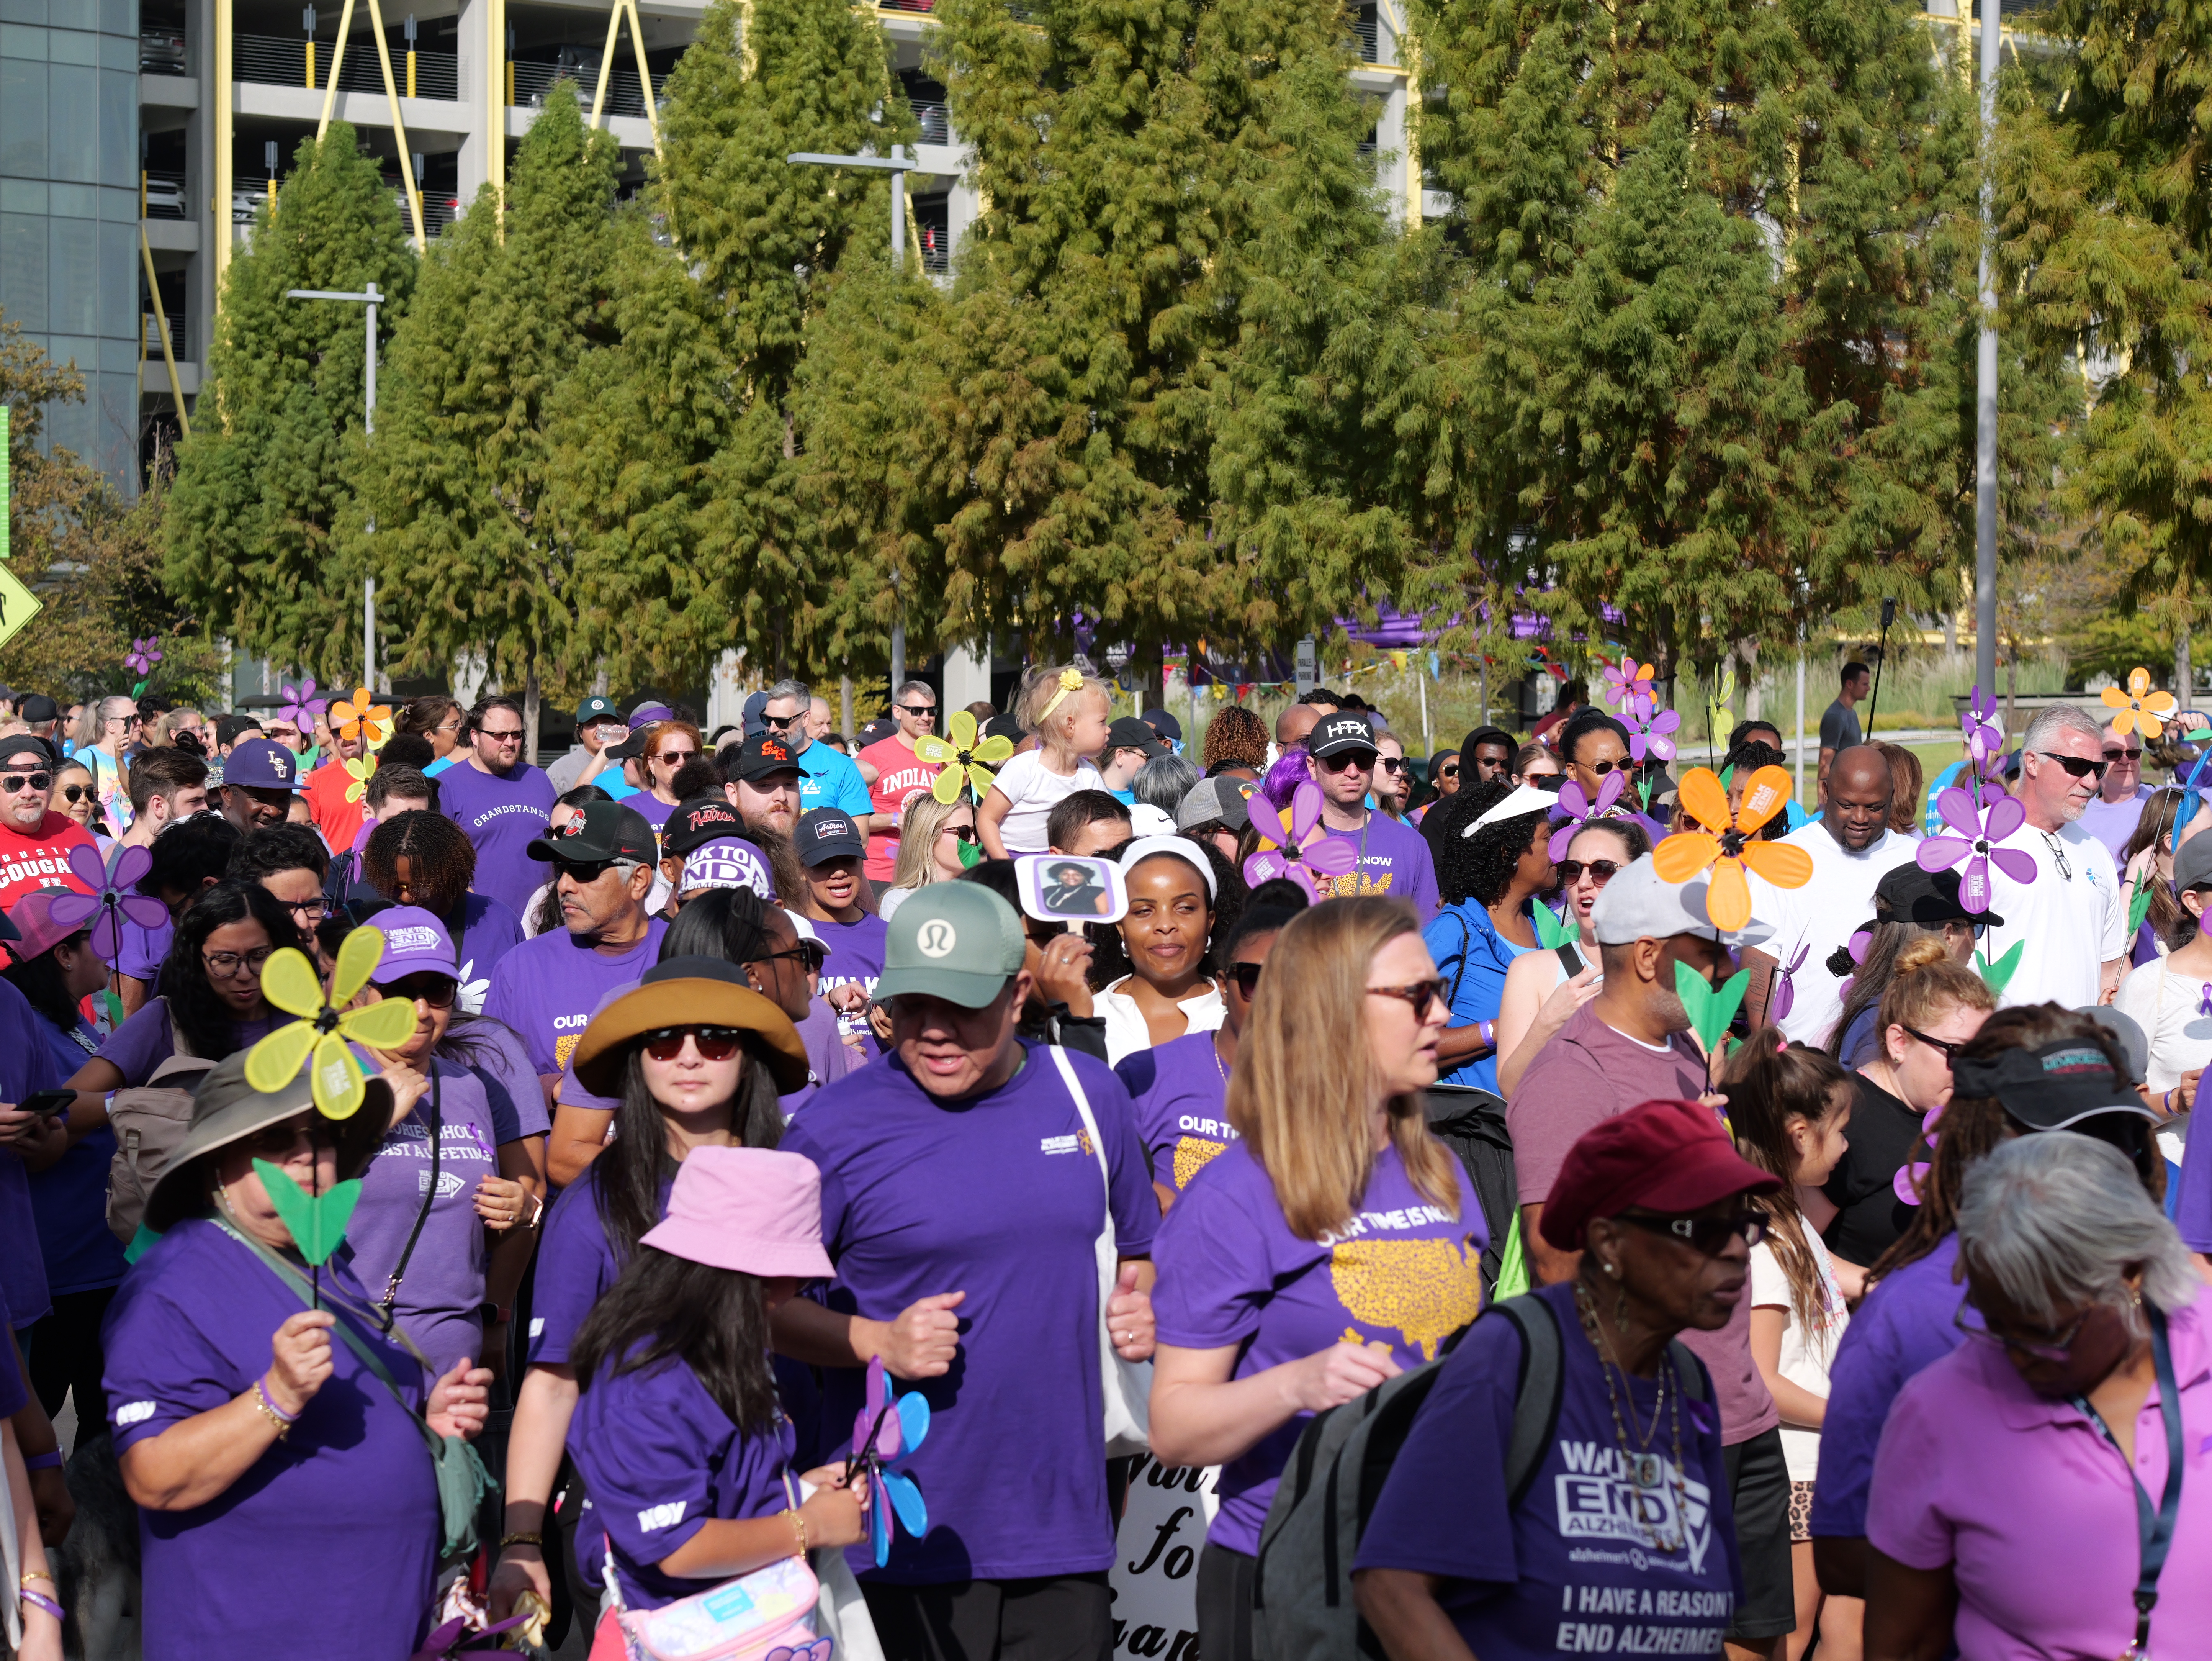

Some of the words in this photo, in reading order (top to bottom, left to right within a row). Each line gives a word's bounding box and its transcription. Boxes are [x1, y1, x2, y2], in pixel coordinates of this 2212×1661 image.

[1327, 721, 1369, 738] HTX
[1658, 740, 1669, 750] WALK
[268, 751, 288, 779] LSU
[1746, 783, 1767, 809] WALK
[1757, 786, 1772, 806] END
[473, 804, 550, 827] GRANDSTANDS
[687, 808, 736, 832] Astros
[818, 822, 844, 833] Astros
[719, 845, 749, 864] TO
[1363, 856, 1392, 868] NOW
[0, 857, 73, 889] COUGA
[685, 862, 746, 881] ND
[1256, 864, 1268, 876] END
[1258, 866, 1276, 882] WALK
[389, 927, 413, 937] WALK
[394, 934, 426, 944] END
[553, 1016, 587, 1031] OUR
[388, 1122, 429, 1139] ORIES
[1179, 1115, 1218, 1133] OUR
[413, 1144, 426, 1158] A
[1360, 1209, 1412, 1230] TIME
[1405, 1206, 1428, 1227] IS
[1566, 1481, 1668, 1524] END
[1562, 1586, 1572, 1612] I
[1578, 1586, 1636, 1614] HAVE
[1639, 1589, 1653, 1615] A
[1656, 1591, 1726, 1617] REASON
[1556, 1622, 1614, 1653] END
